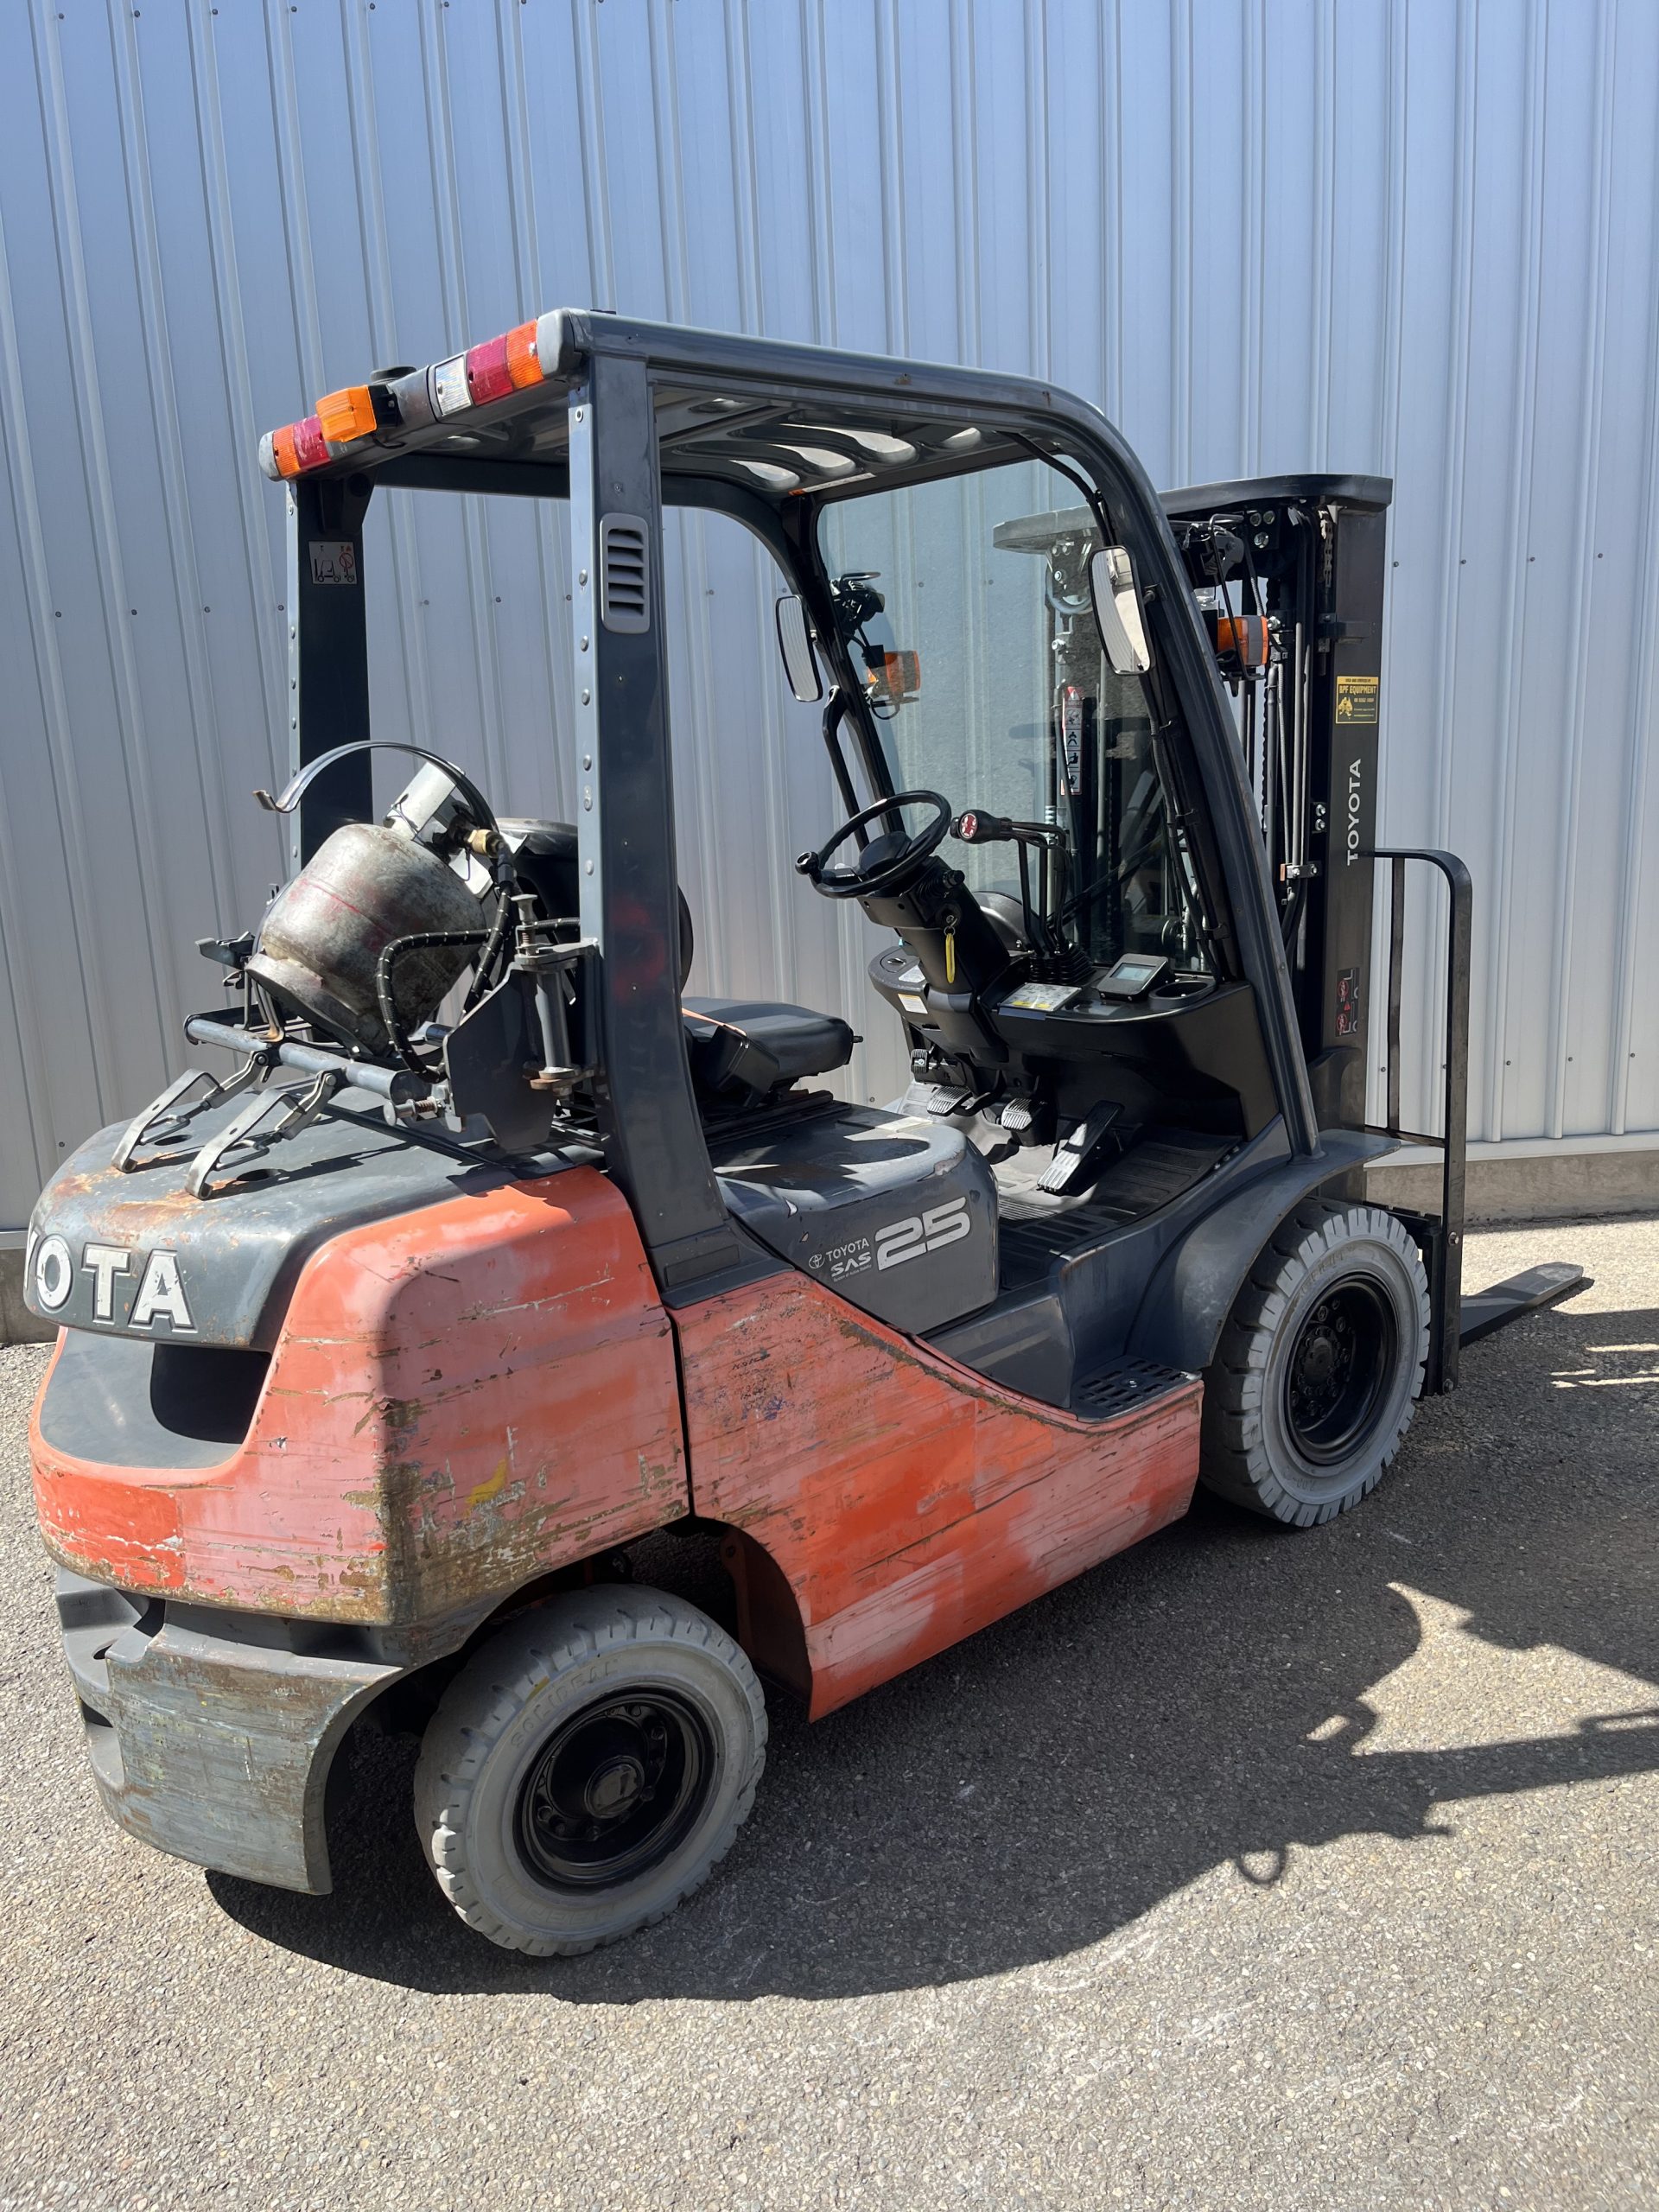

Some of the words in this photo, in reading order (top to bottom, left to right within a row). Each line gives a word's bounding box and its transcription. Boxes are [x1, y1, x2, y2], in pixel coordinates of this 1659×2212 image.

[1350, 685, 1376, 695] EQUIPMENT
[1347, 759, 1361, 866] TOYOTA
[825, 1237, 870, 1262] TOYOTA
[874, 1196, 971, 1271] 25
[830, 1251, 872, 1277] SAS
[511, 1658, 619, 1748] SOLIDEAL
